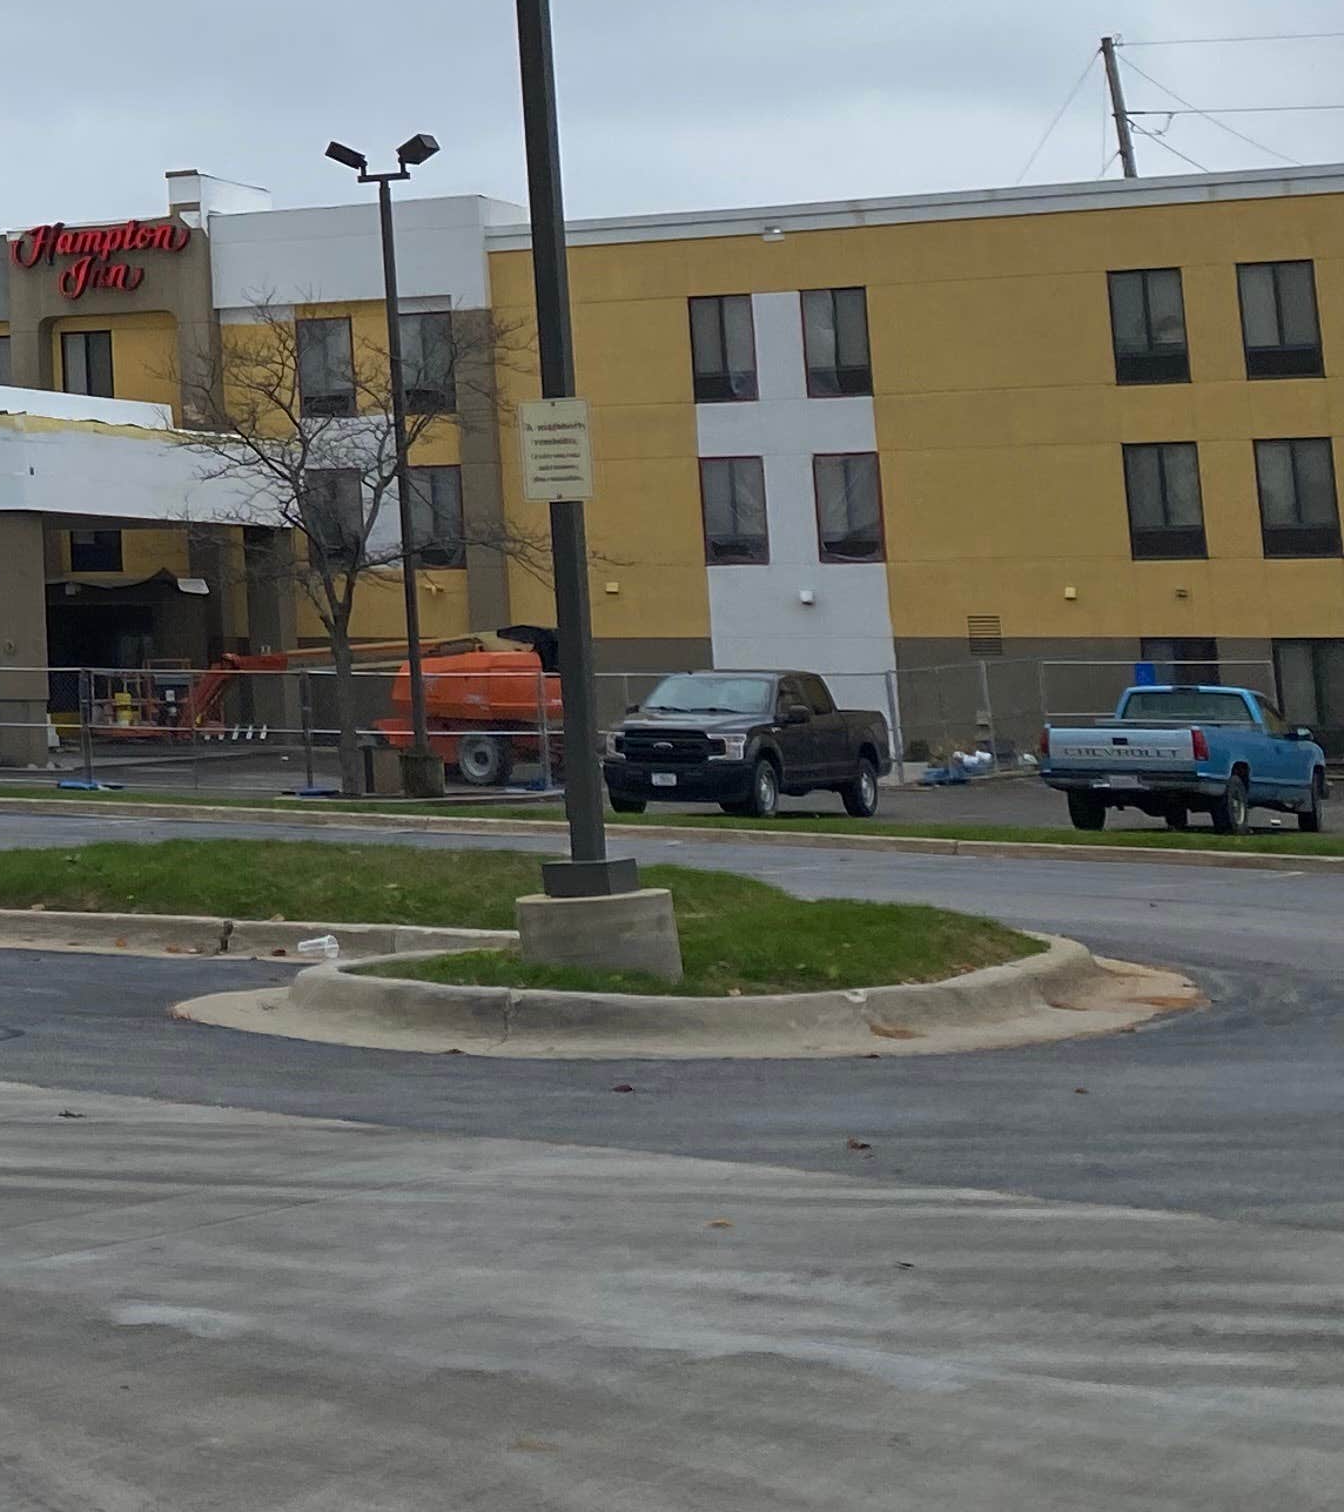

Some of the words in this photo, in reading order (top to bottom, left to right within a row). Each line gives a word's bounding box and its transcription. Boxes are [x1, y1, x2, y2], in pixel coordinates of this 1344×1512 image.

[11, 219, 192, 269] Hampton
[58, 254, 145, 301] Inn
[1064, 746, 1181, 759] CHEVROLET
